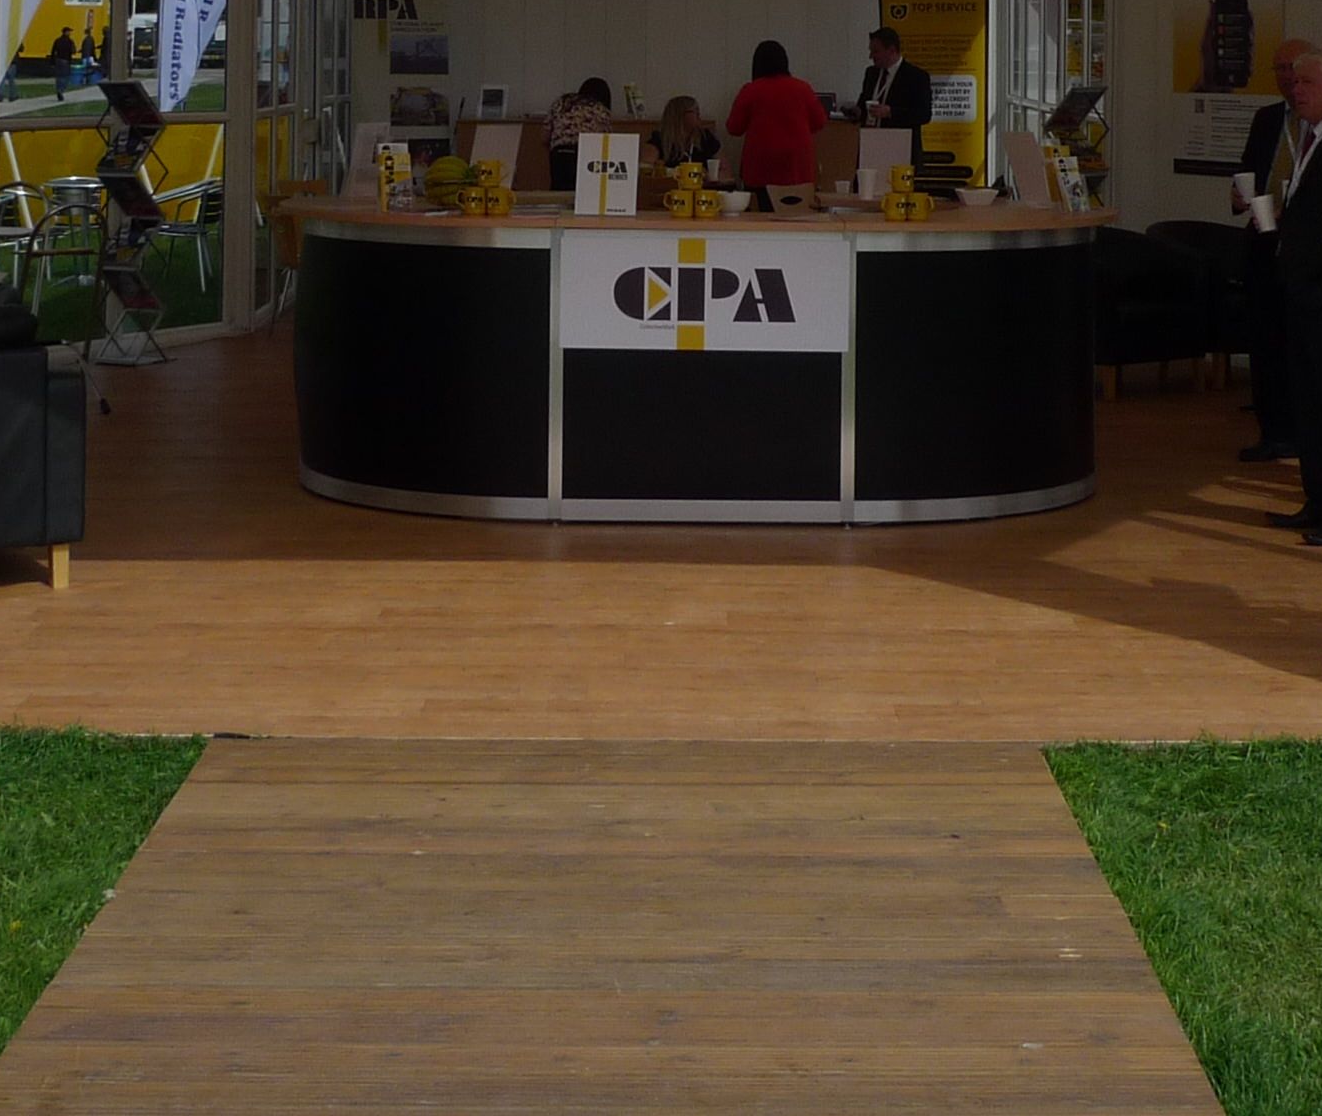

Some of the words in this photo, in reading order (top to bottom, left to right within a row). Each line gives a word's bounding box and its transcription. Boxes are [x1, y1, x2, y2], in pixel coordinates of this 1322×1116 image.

[912, 2, 933, 12] TOP
[936, 2, 978, 12] SERVICE
[587, 161, 627, 172] CPA
[613, 266, 796, 323] CPA
